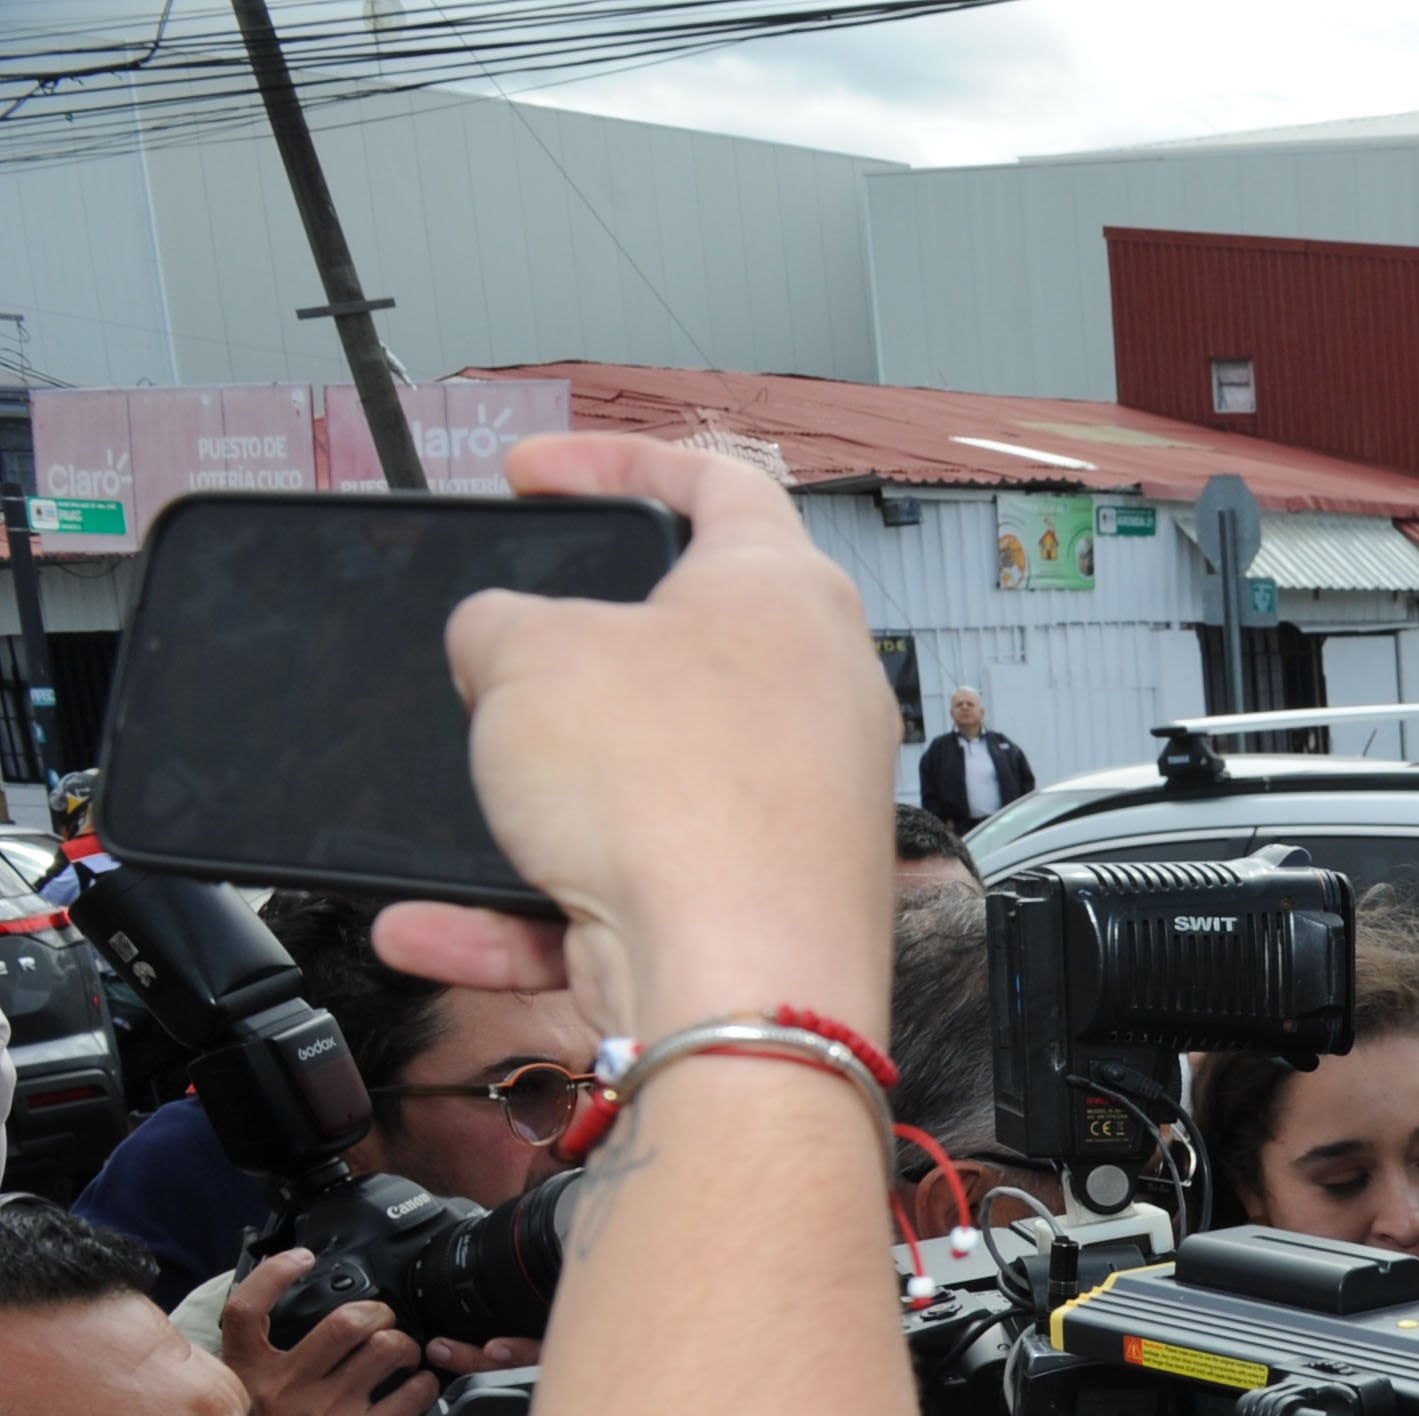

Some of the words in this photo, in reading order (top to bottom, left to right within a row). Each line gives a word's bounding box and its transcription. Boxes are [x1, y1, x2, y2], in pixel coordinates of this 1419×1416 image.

[197, 437, 259, 460] PUESTO
[263, 436, 287, 459] DE
[412, 421, 499, 459] laro
[47, 463, 122, 498] Claro
[189, 467, 254, 490] LOTERÍA
[258, 469, 303, 490] CUCO
[341, 480, 389, 494] PUES
[1174, 915, 1238, 932] SWIT
[297, 1035, 337, 1061] Godox
[386, 1192, 432, 1220] Canon
